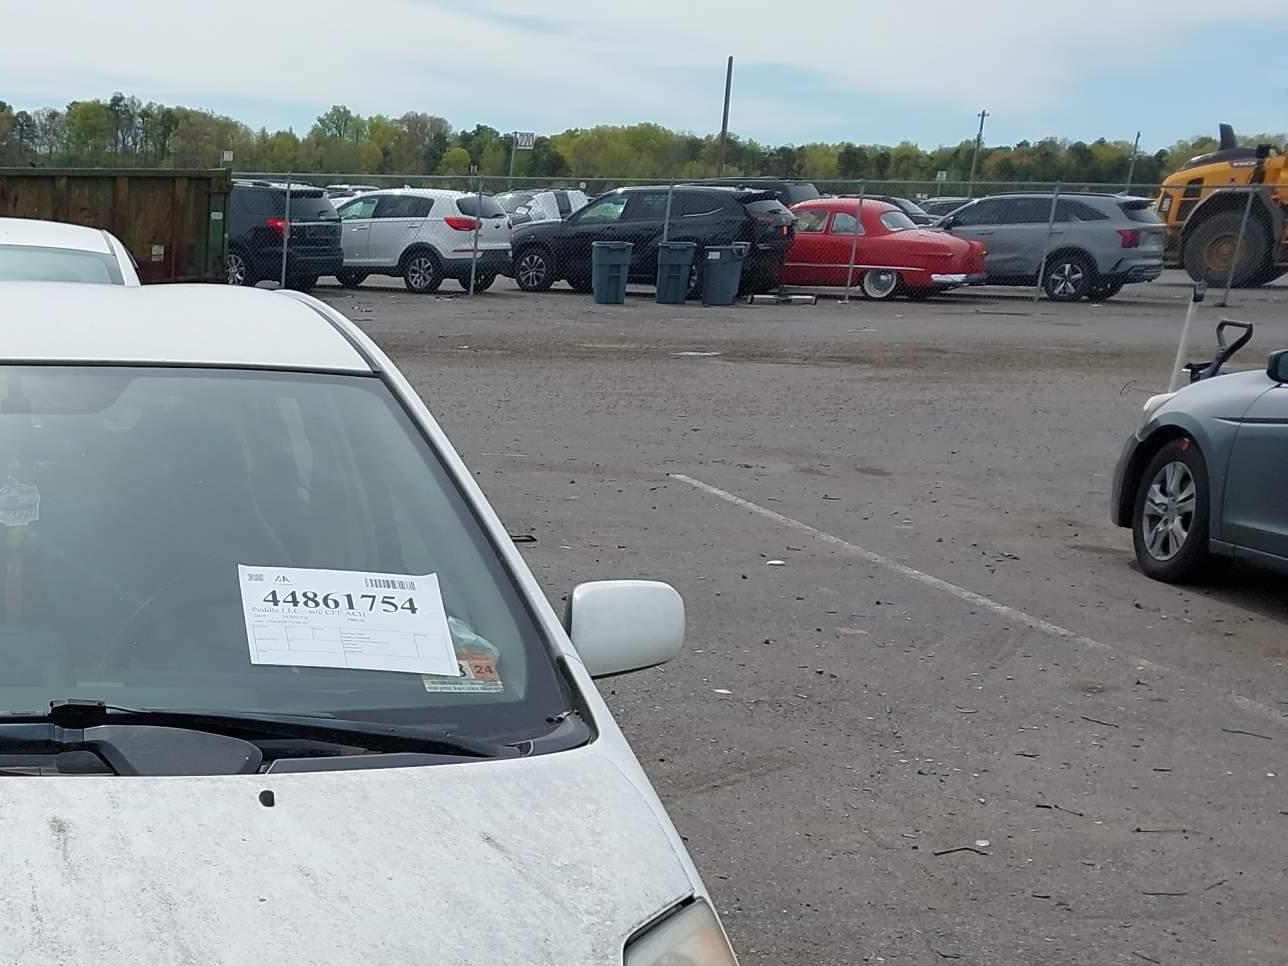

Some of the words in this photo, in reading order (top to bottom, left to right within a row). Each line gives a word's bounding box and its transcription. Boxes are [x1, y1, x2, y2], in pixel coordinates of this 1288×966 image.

[519, 134, 534, 147] 220
[262, 589, 418, 615] 44861754
[474, 665, 494, 674] 24
